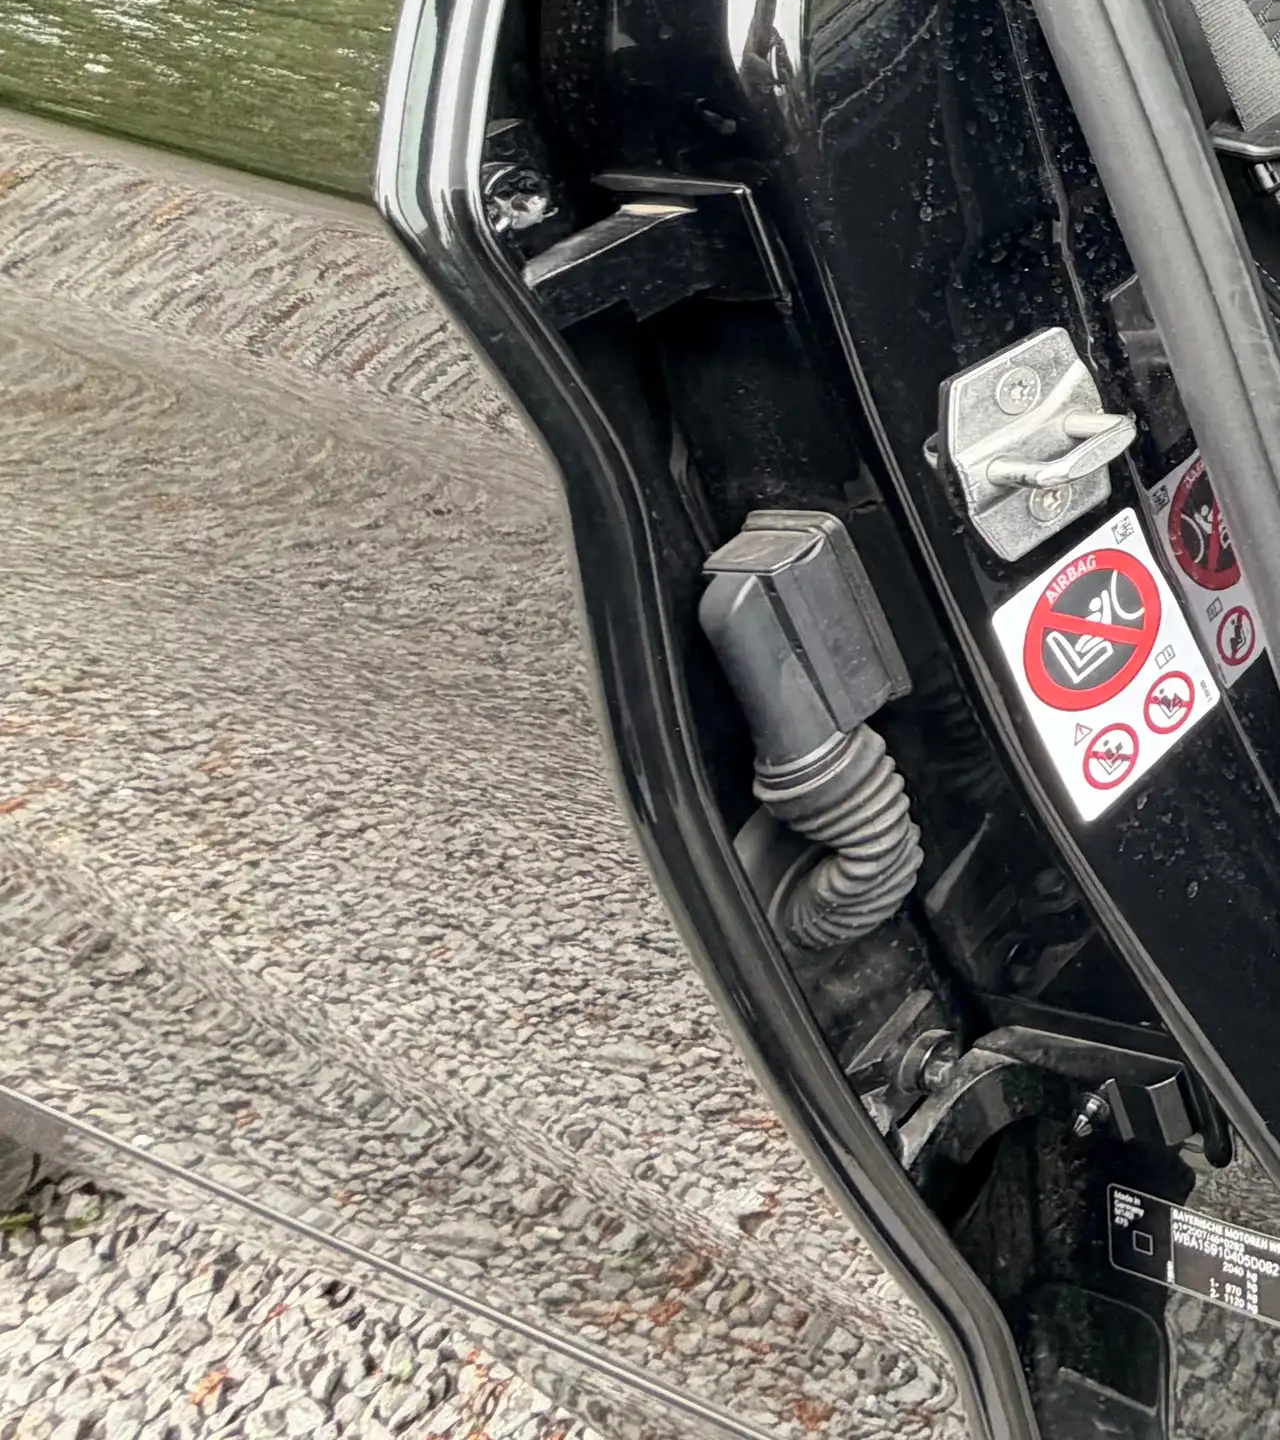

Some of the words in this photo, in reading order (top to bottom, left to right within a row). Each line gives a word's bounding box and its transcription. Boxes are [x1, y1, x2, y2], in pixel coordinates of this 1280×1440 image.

[1045, 554, 1097, 605] AIRBAG
[1172, 1208, 1223, 1233] BAYERISCHE
[1222, 1261, 1244, 1277] 2040
[1246, 1269, 1258, 1283] kg
[1224, 1293, 1245, 1308] 1120
